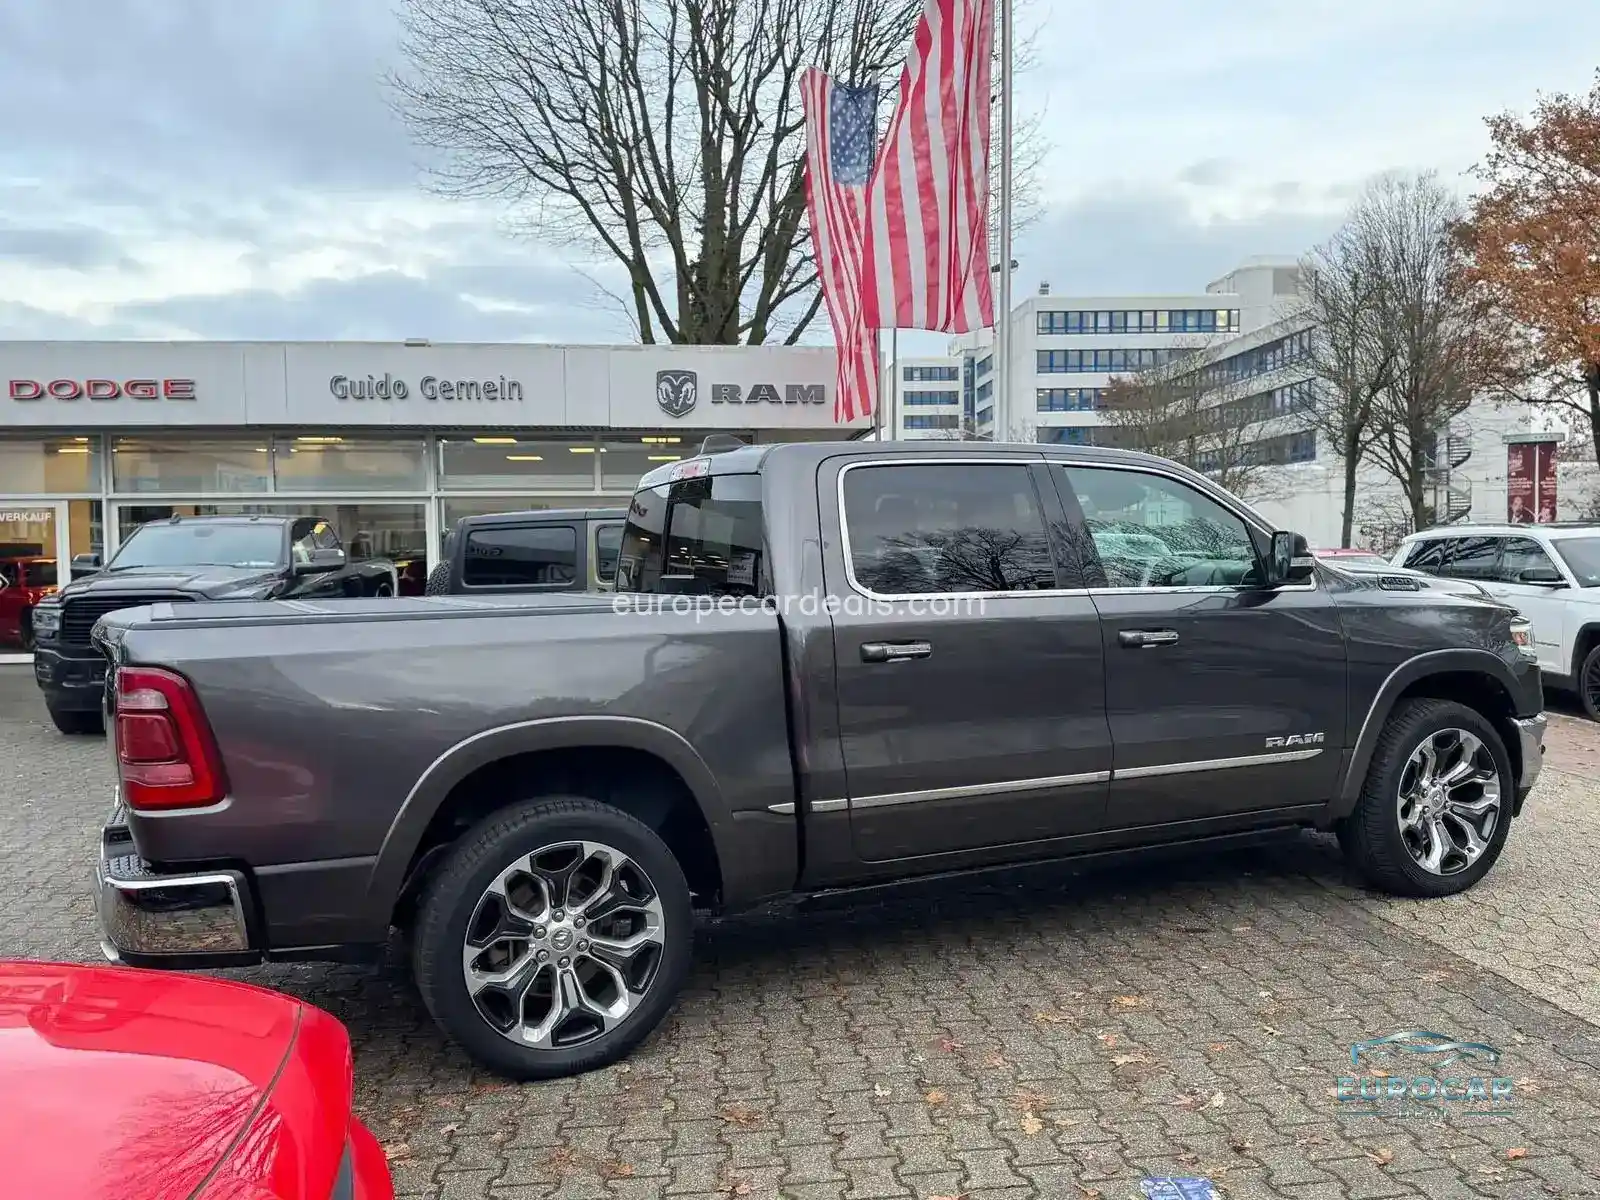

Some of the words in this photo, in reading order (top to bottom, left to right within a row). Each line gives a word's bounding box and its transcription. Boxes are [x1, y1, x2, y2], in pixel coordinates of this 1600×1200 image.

[9, 379, 196, 400] DODGE
[330, 373, 409, 400] Guido
[420, 375, 523, 400] Gemein
[711, 384, 826, 404] RAM
[1265, 732, 1325, 748] RAM
